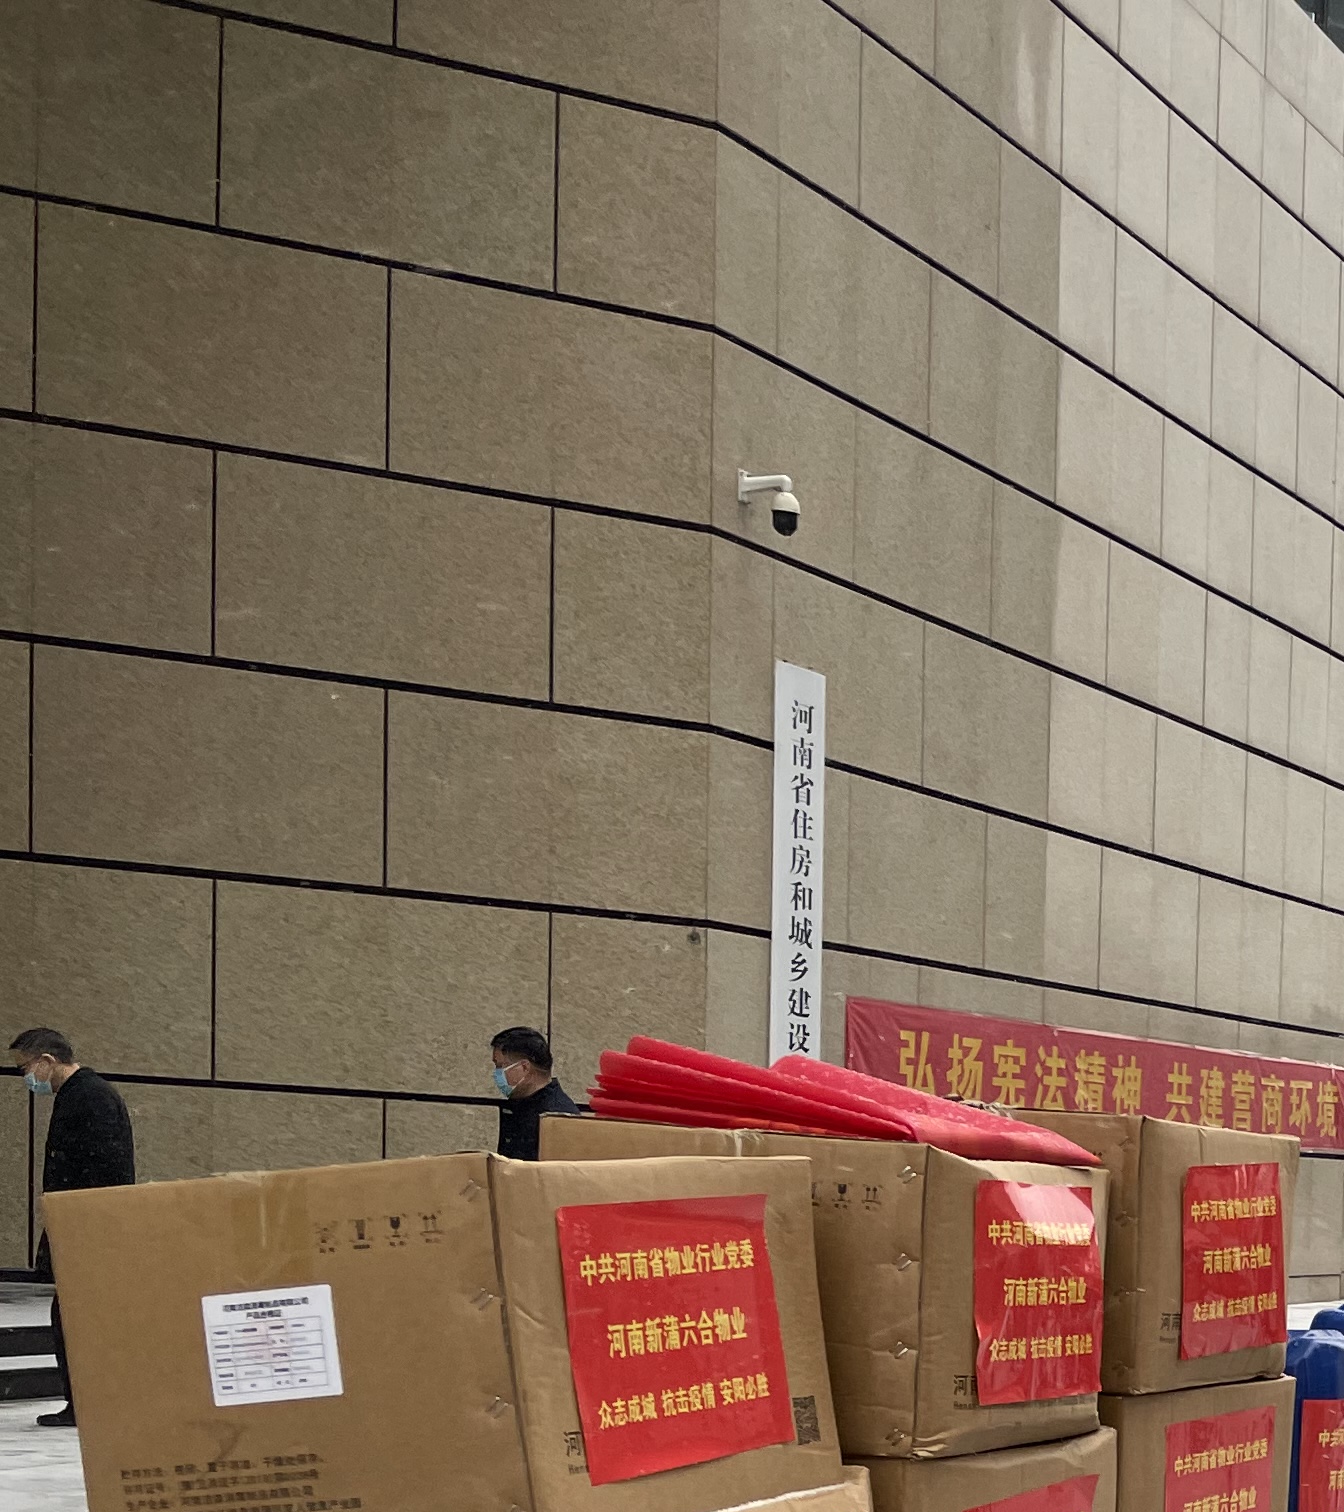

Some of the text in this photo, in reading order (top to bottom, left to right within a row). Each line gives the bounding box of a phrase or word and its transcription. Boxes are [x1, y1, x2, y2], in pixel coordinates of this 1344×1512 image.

[786, 699, 815, 1054] 河南省住房和城乡建设
[899, 1029, 1143, 1117] 弘扬宪法精神
[1165, 1061, 1339, 1138] 共建营商环境
[1191, 1196, 1276, 1222] 中共河南省物业行业党委
[581, 1239, 753, 1285] 中共河南省物业行业党委
[1204, 1244, 1270, 1273] 河南新蒲六合物业
[1004, 1277, 1086, 1306] 河南新蒲六合物业
[608, 1307, 746, 1357] 河南新蒲六合物业
[599, 1374, 769, 1428] 众志成城 抗击疫情 安阳必胜
[1175, 1439, 1267, 1475] 中共河南省物业行业党委
